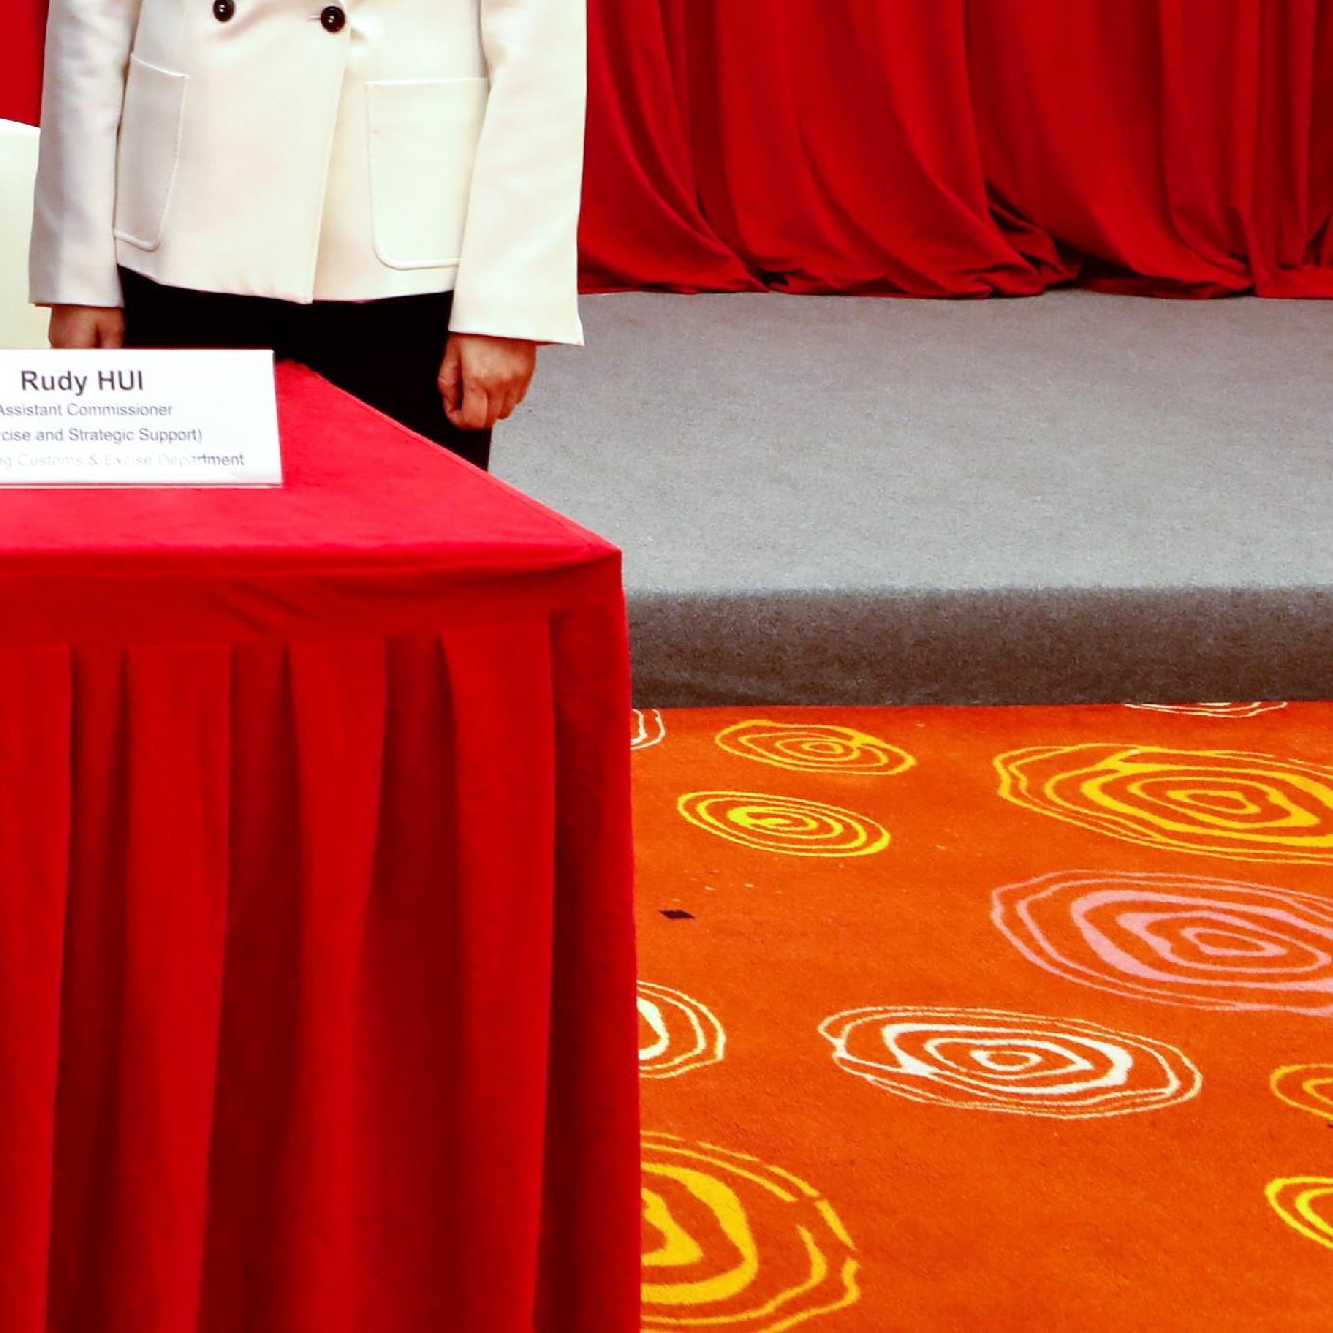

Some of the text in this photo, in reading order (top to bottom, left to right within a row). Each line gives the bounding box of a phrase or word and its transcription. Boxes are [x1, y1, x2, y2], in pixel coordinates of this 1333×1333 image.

[21, 370, 144, 397] Rudy HUI
[67, 403, 173, 417] Commissioner
[35, 428, 64, 442] and
[68, 427, 134, 444] Strategic
[139, 427, 203, 444] Support)
